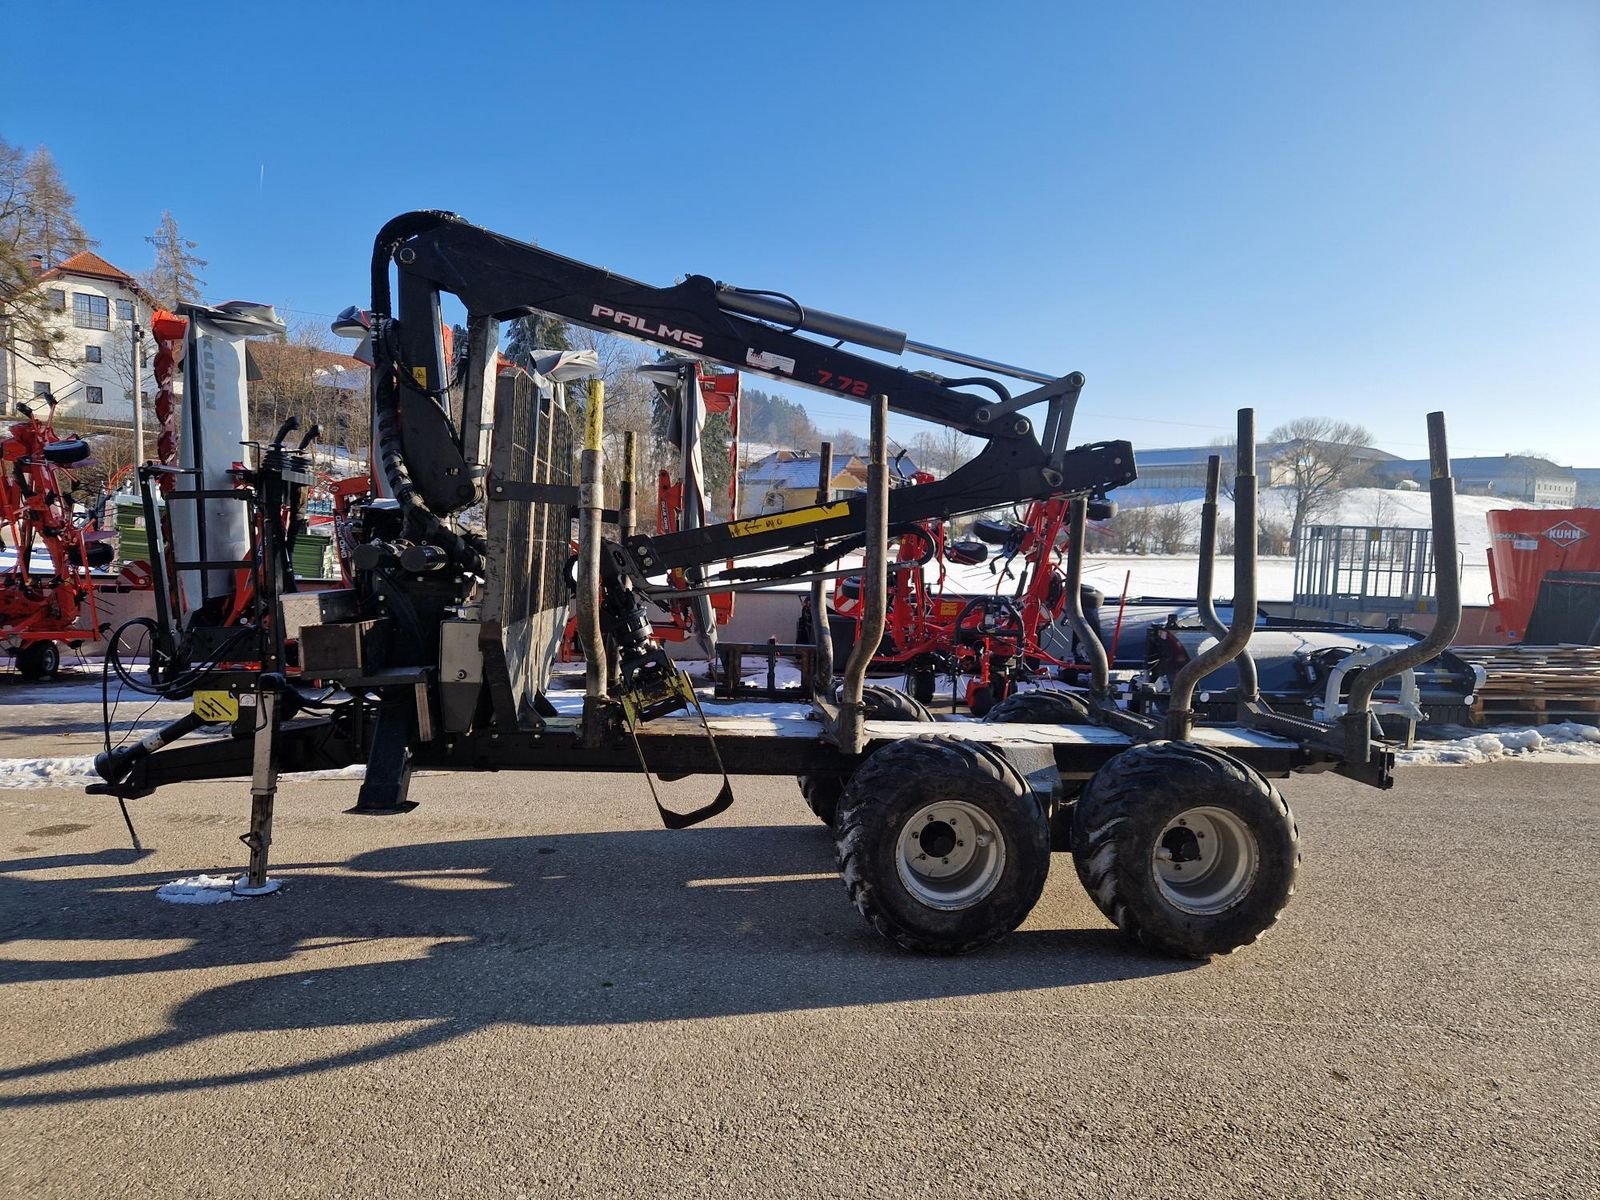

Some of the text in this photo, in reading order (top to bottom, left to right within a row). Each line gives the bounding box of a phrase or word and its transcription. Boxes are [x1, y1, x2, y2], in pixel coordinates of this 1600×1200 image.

[591, 304, 704, 349] PALMS
[203, 335, 217, 410] KUHN
[1548, 529, 1581, 539] KUHN
